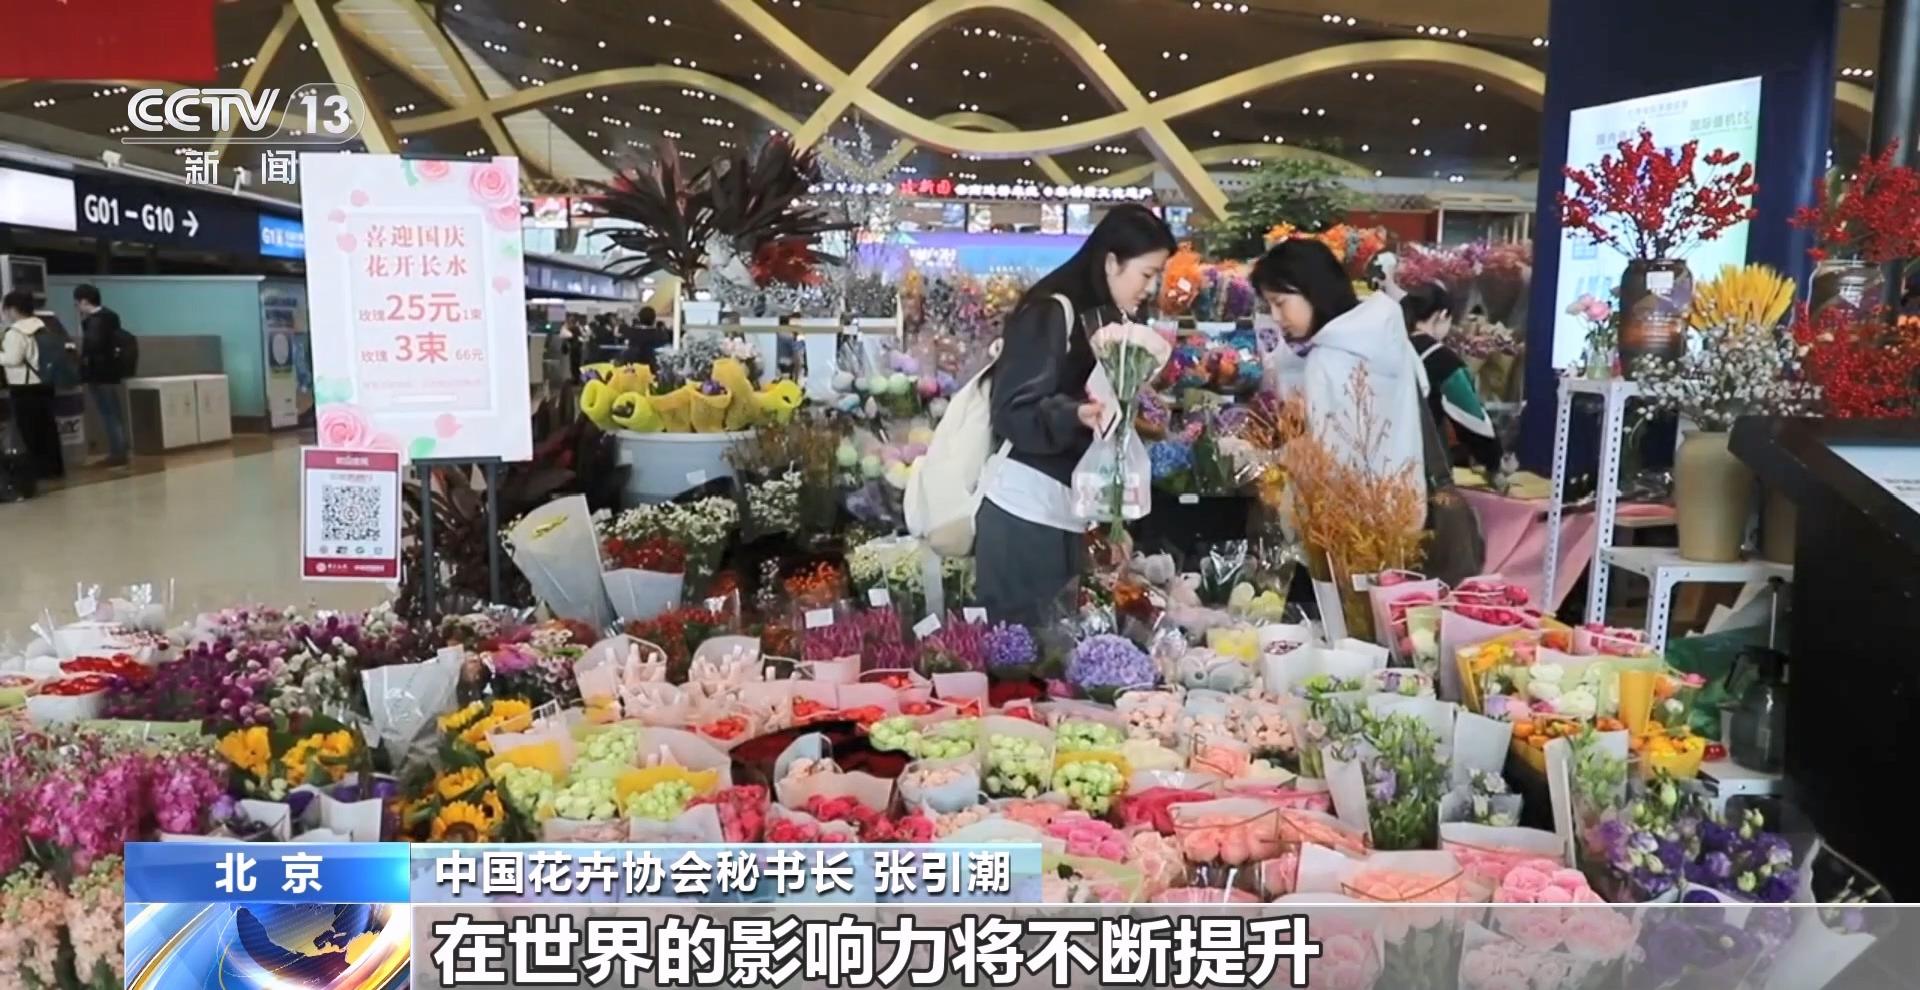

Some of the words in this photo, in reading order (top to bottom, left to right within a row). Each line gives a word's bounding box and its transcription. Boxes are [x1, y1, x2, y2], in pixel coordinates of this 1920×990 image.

[366, 225, 466, 248] 喜迎国庆
[366, 254, 468, 278] 花开长水
[360, 350, 388, 363] 玫瑰
[394, 331, 449, 364] 3束
[455, 349, 484, 362] 66元
